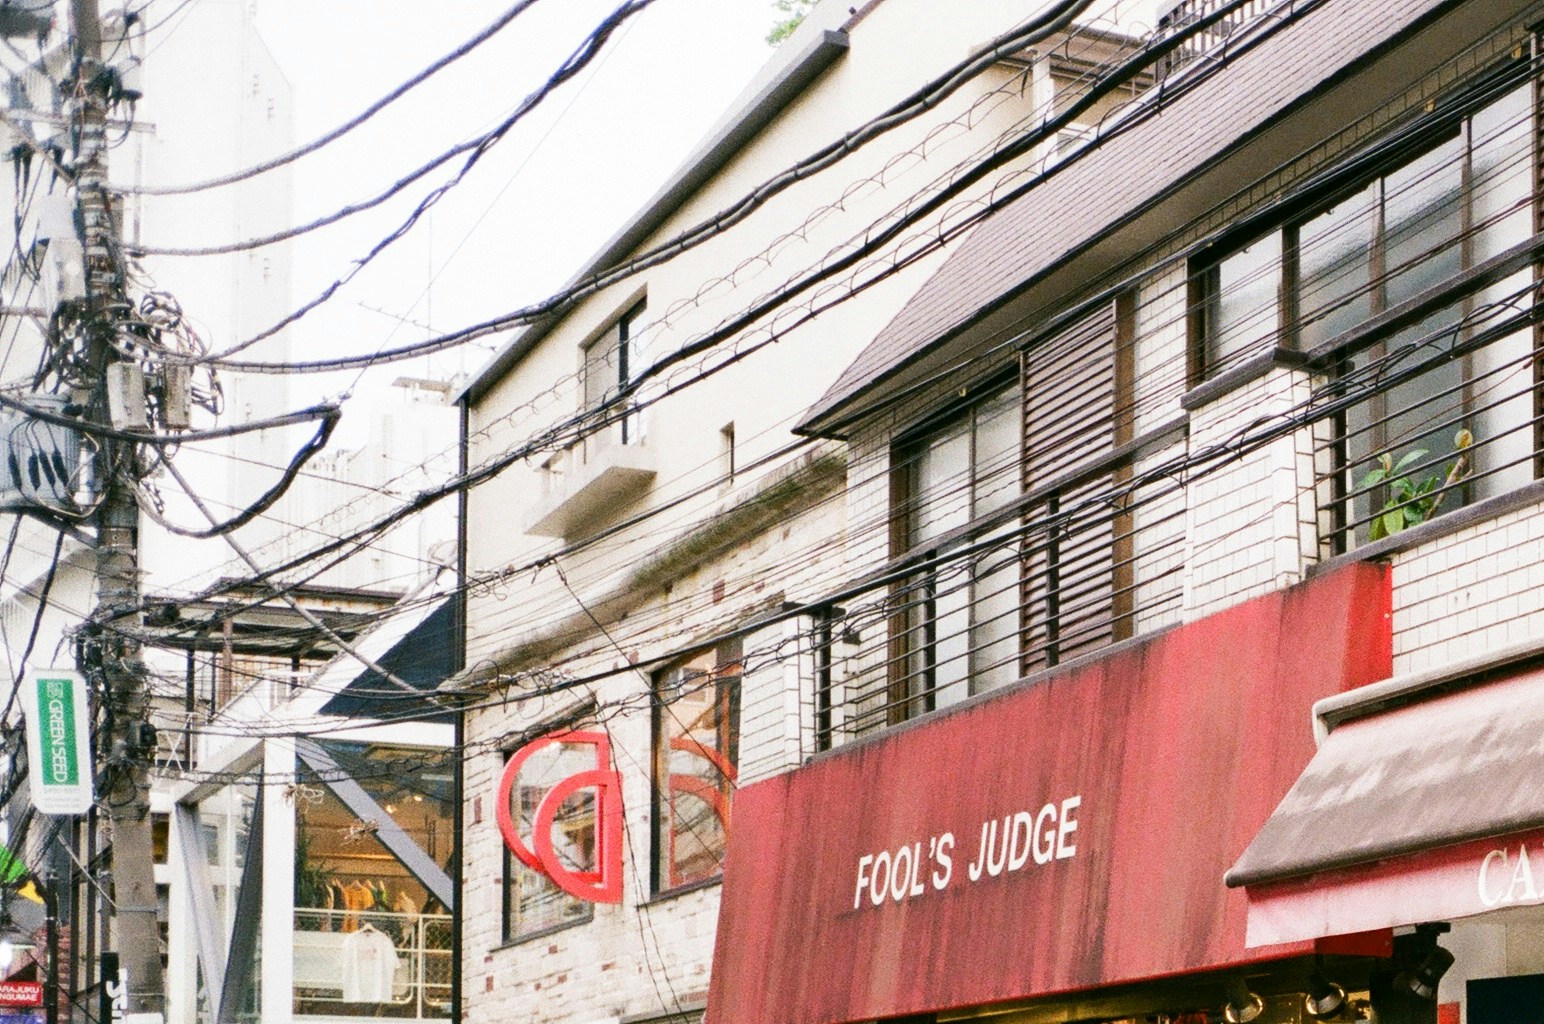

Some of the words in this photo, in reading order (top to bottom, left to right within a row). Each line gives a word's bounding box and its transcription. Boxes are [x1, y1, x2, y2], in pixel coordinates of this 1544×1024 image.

[49, 700, 65, 745] GREEN
[51, 746, 68, 782] SEED
[853, 832, 955, 910] FOOL'S
[968, 795, 1081, 882] JUDGE
